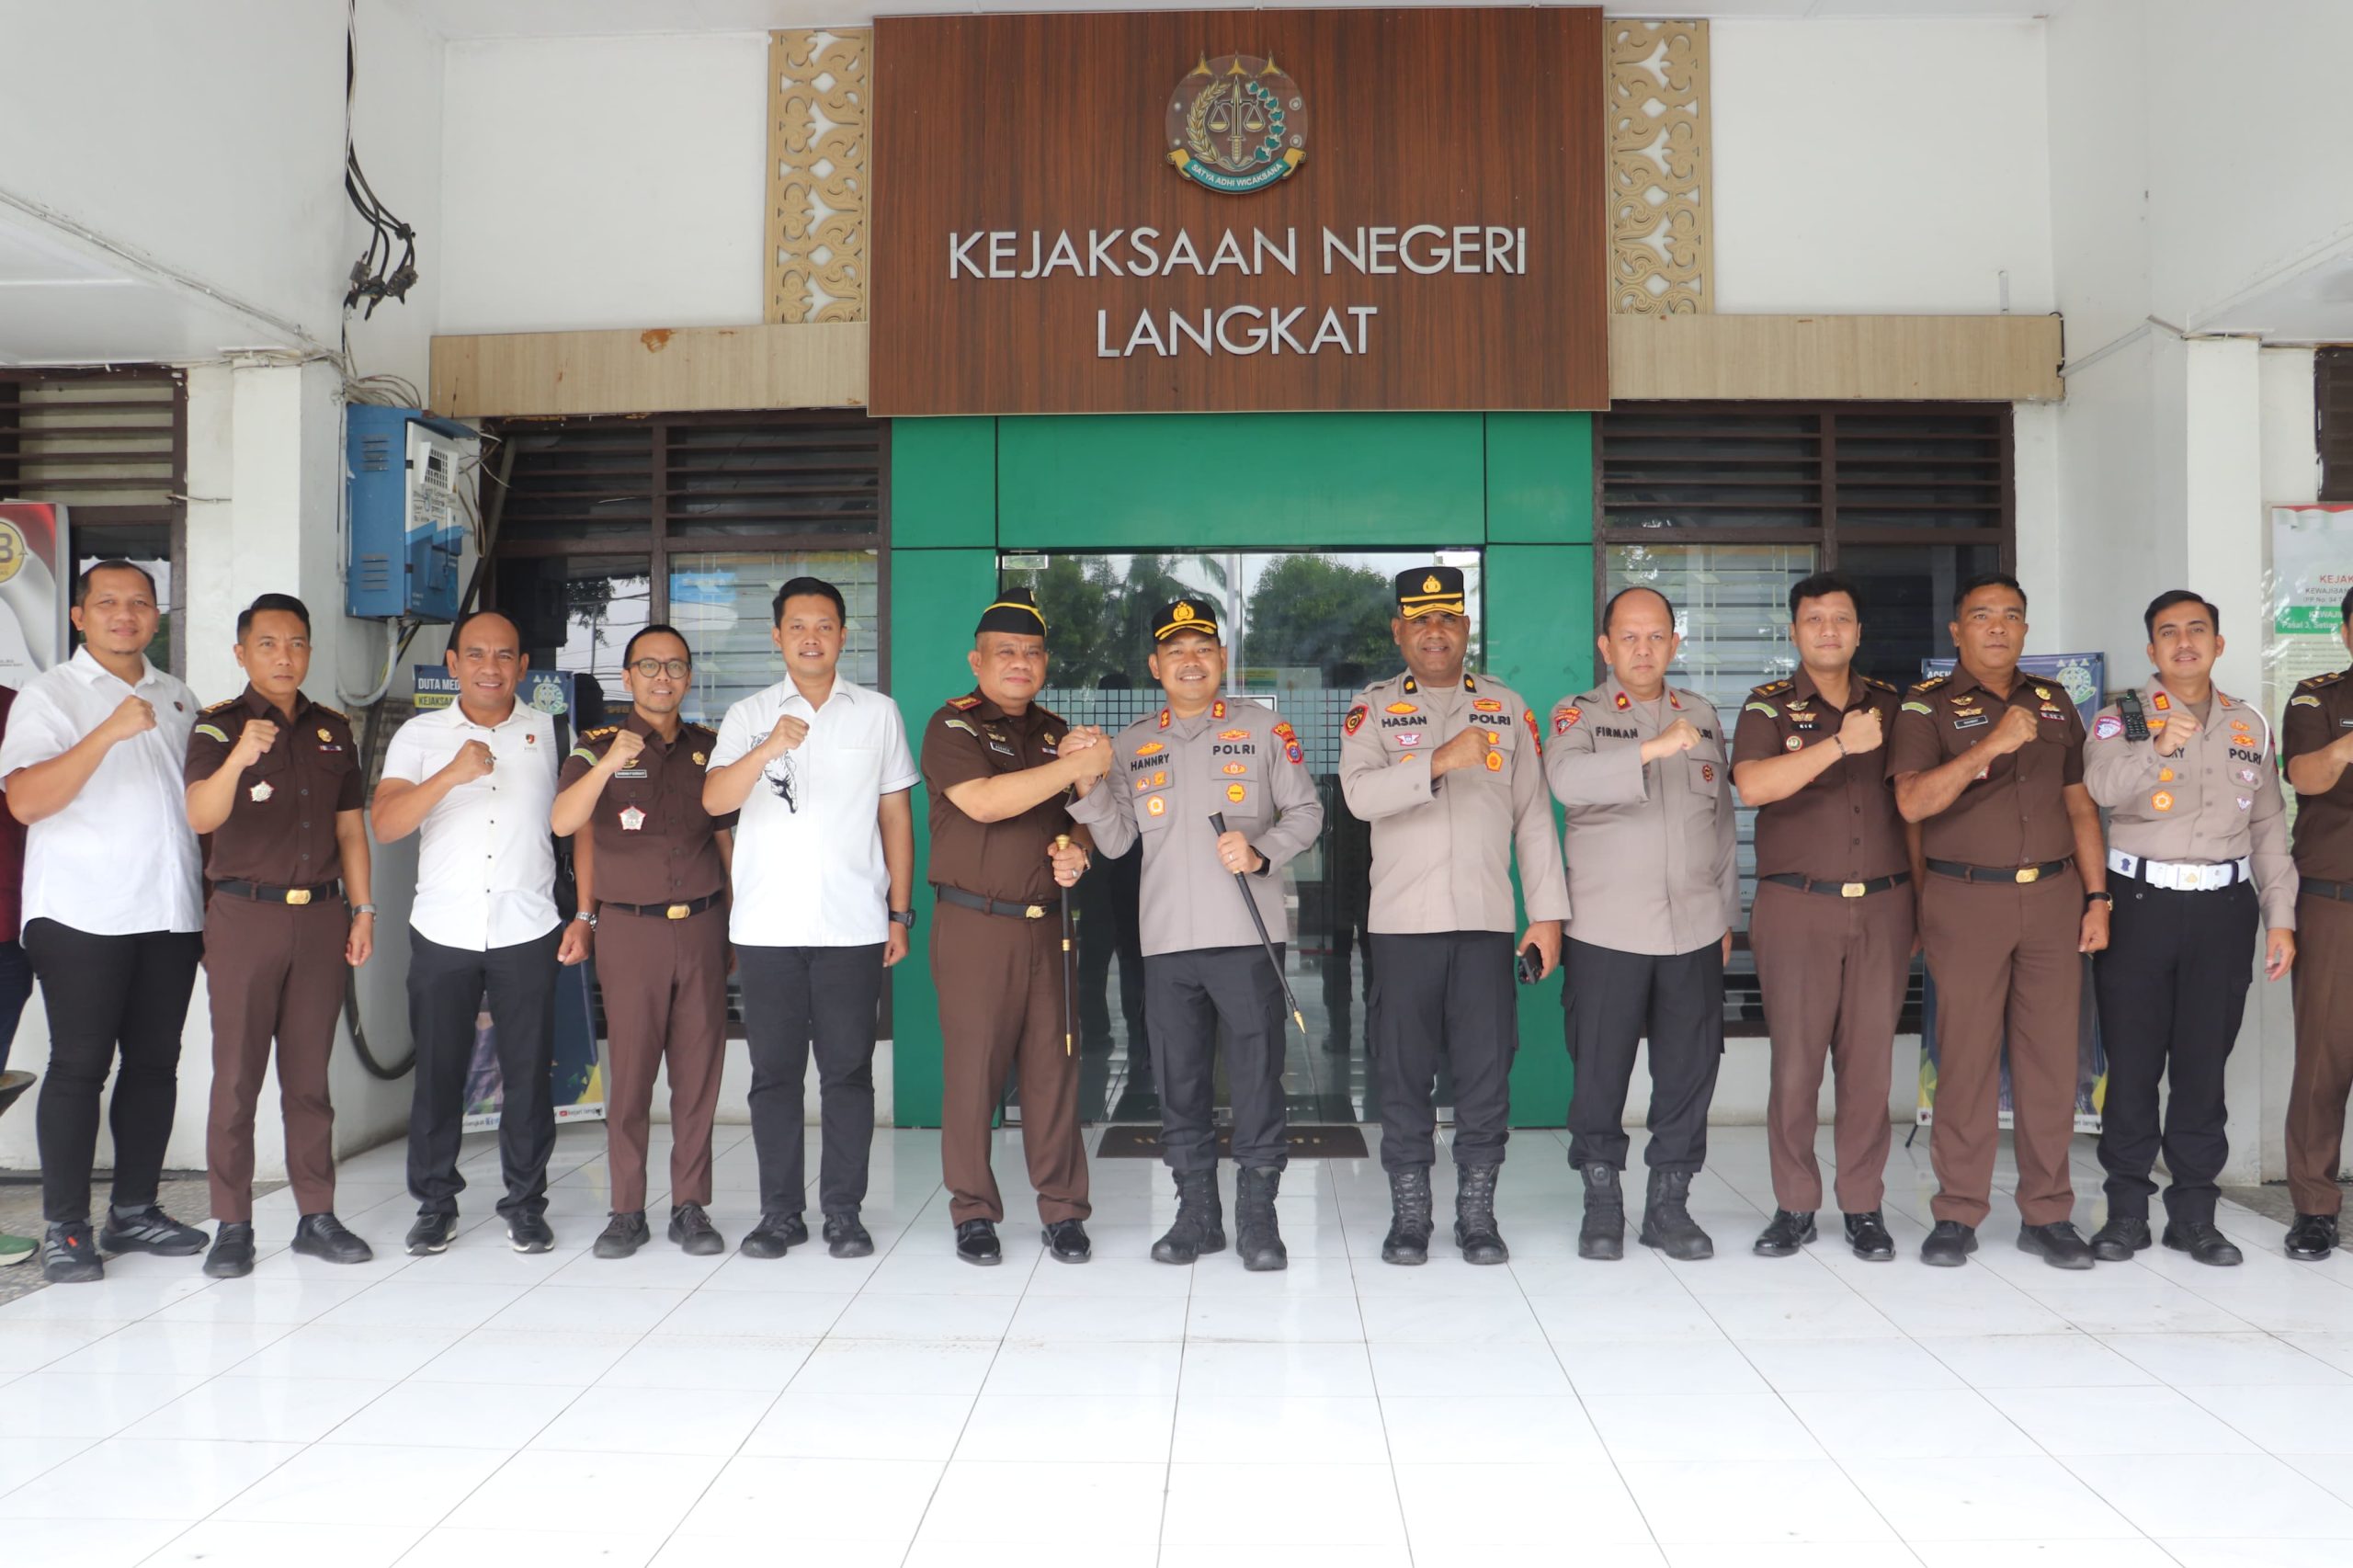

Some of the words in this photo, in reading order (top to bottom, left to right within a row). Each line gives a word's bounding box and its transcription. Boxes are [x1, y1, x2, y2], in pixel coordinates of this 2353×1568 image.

[1191, 164, 1214, 182] SATYA
[1215, 177, 1235, 187] ADHI
[1236, 164, 1283, 187] WICAKSANA
[949, 226, 1297, 279] KEJAKSAAN
[1323, 223, 1527, 275] NEGERI
[1097, 304, 1378, 358] LANGKAT
[418, 677, 440, 690] DUTA
[1381, 713, 1427, 728] HASAN
[1469, 713, 1511, 726] POLRI
[1595, 726, 1638, 739] FIRMAN
[1212, 744, 1256, 756] POLRI
[2228, 747, 2263, 766] POLRI
[1131, 754, 1170, 772] HANNRY
